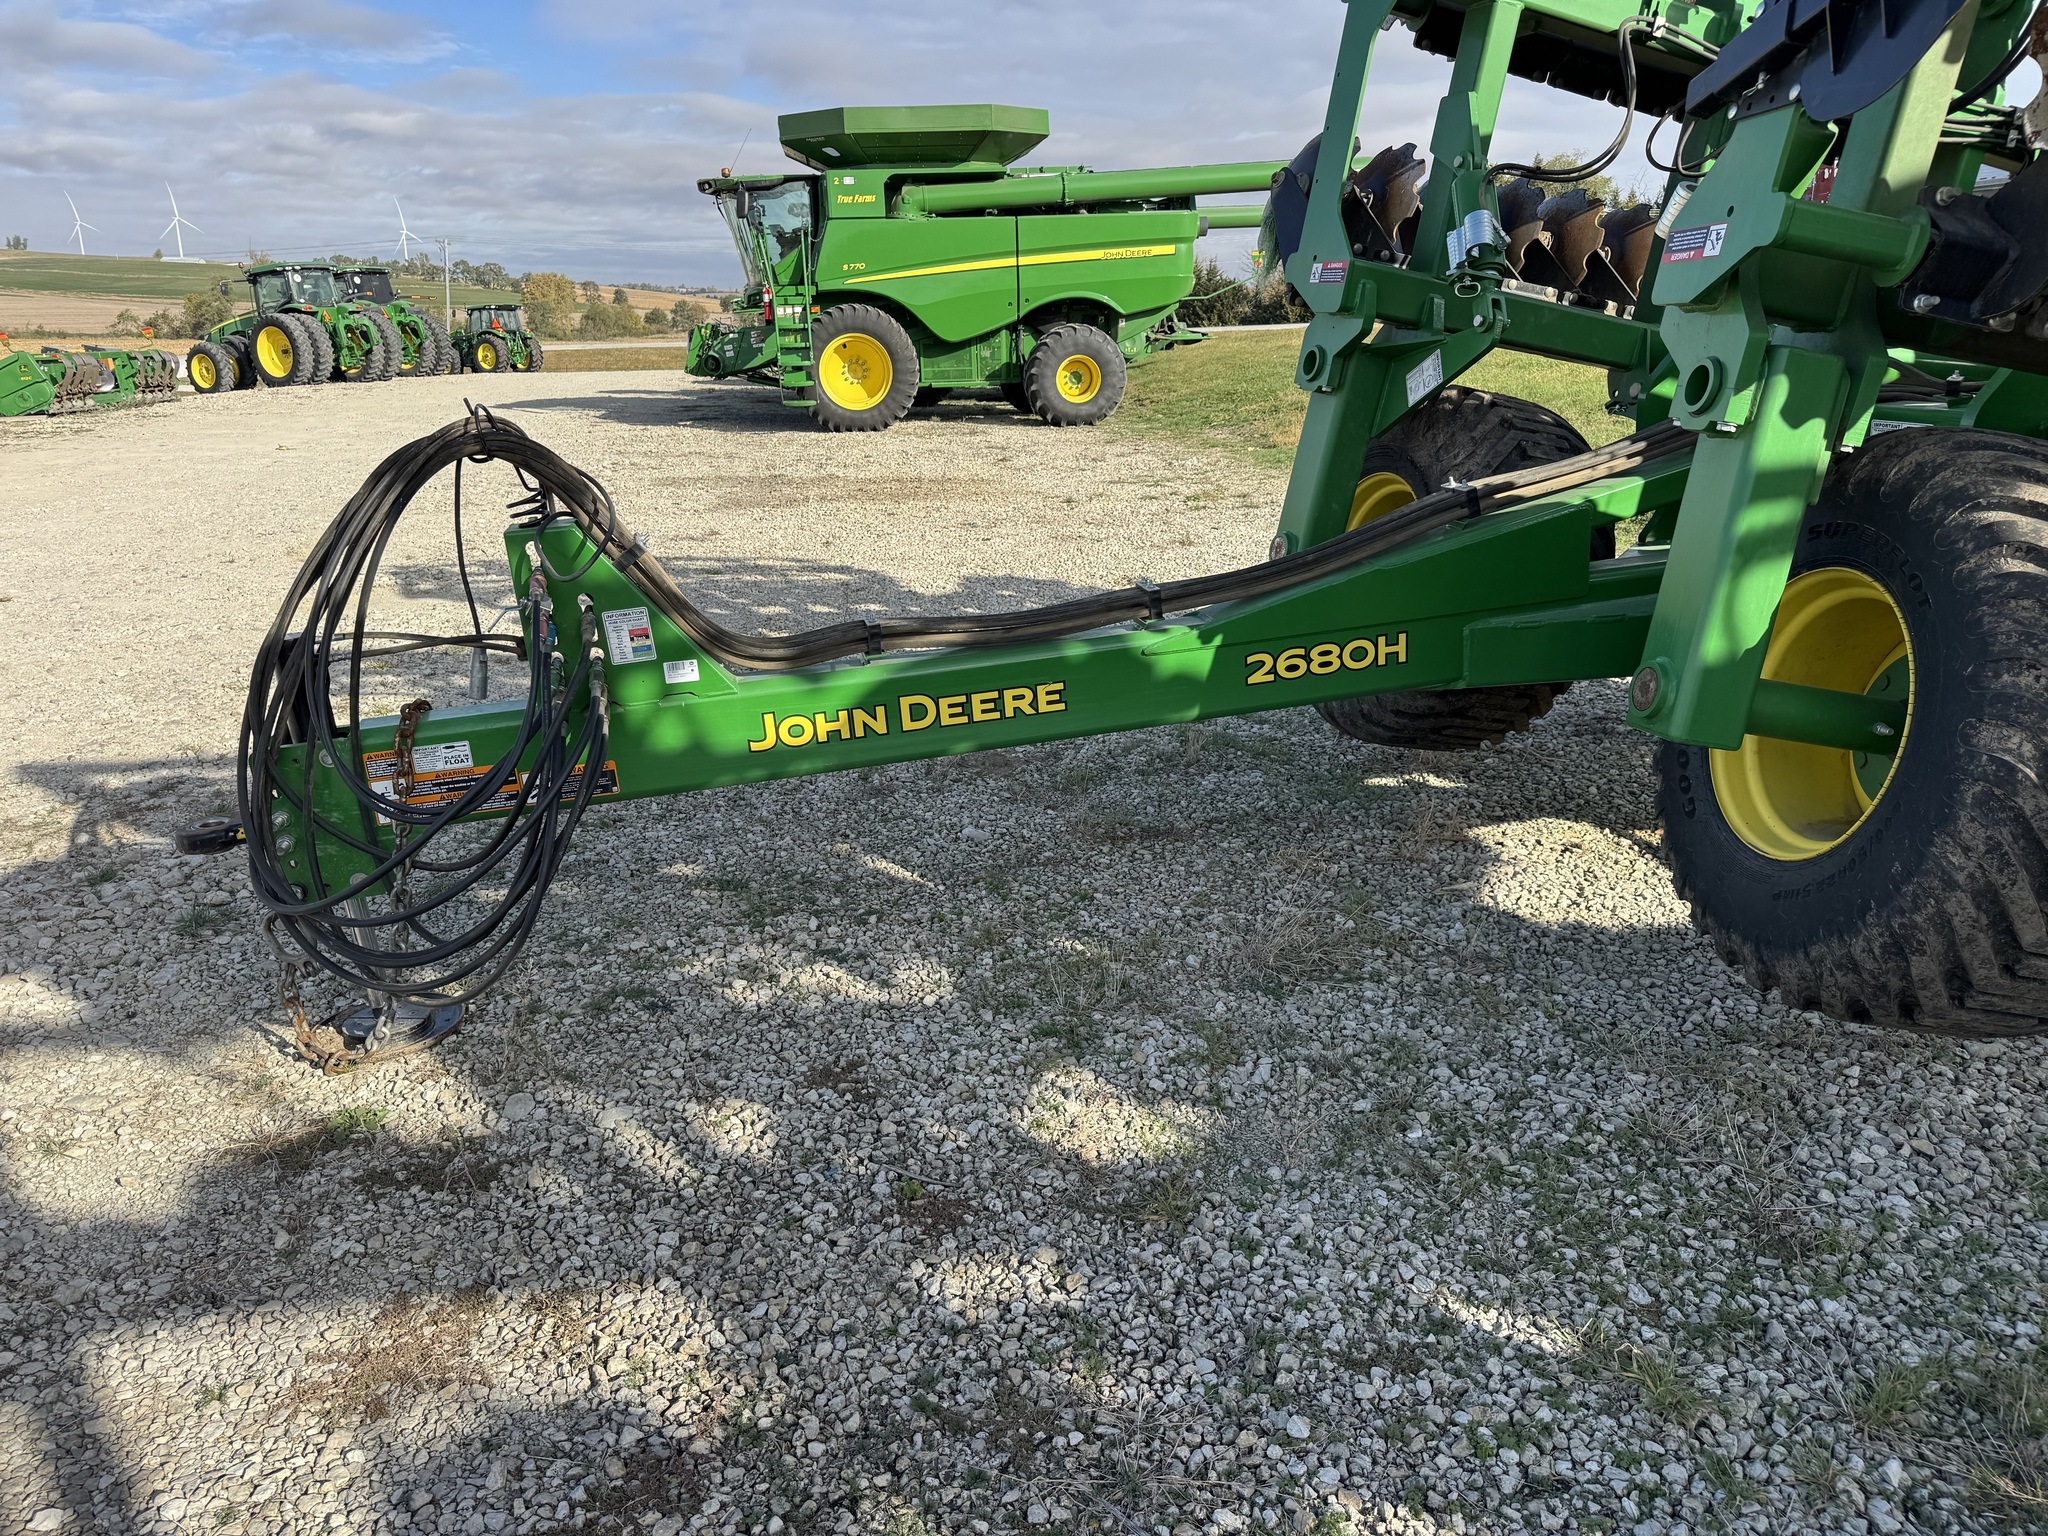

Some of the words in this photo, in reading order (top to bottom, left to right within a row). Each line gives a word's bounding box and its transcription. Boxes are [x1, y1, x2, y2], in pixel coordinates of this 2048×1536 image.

[833, 177, 840, 185] 2
[837, 195, 853, 204] True
[853, 194, 877, 203] Farms
[1101, 251, 1124, 259] JOHN
[1125, 248, 1153, 257] DEERE
[605, 610, 645, 620] INFORMATION
[1245, 631, 1408, 686] 2680H
[748, 711, 890, 752] JOHN
[898, 681, 1066, 732] DEERE
[444, 757, 470, 766] FLOAT
[440, 768, 476, 778] WARNING
